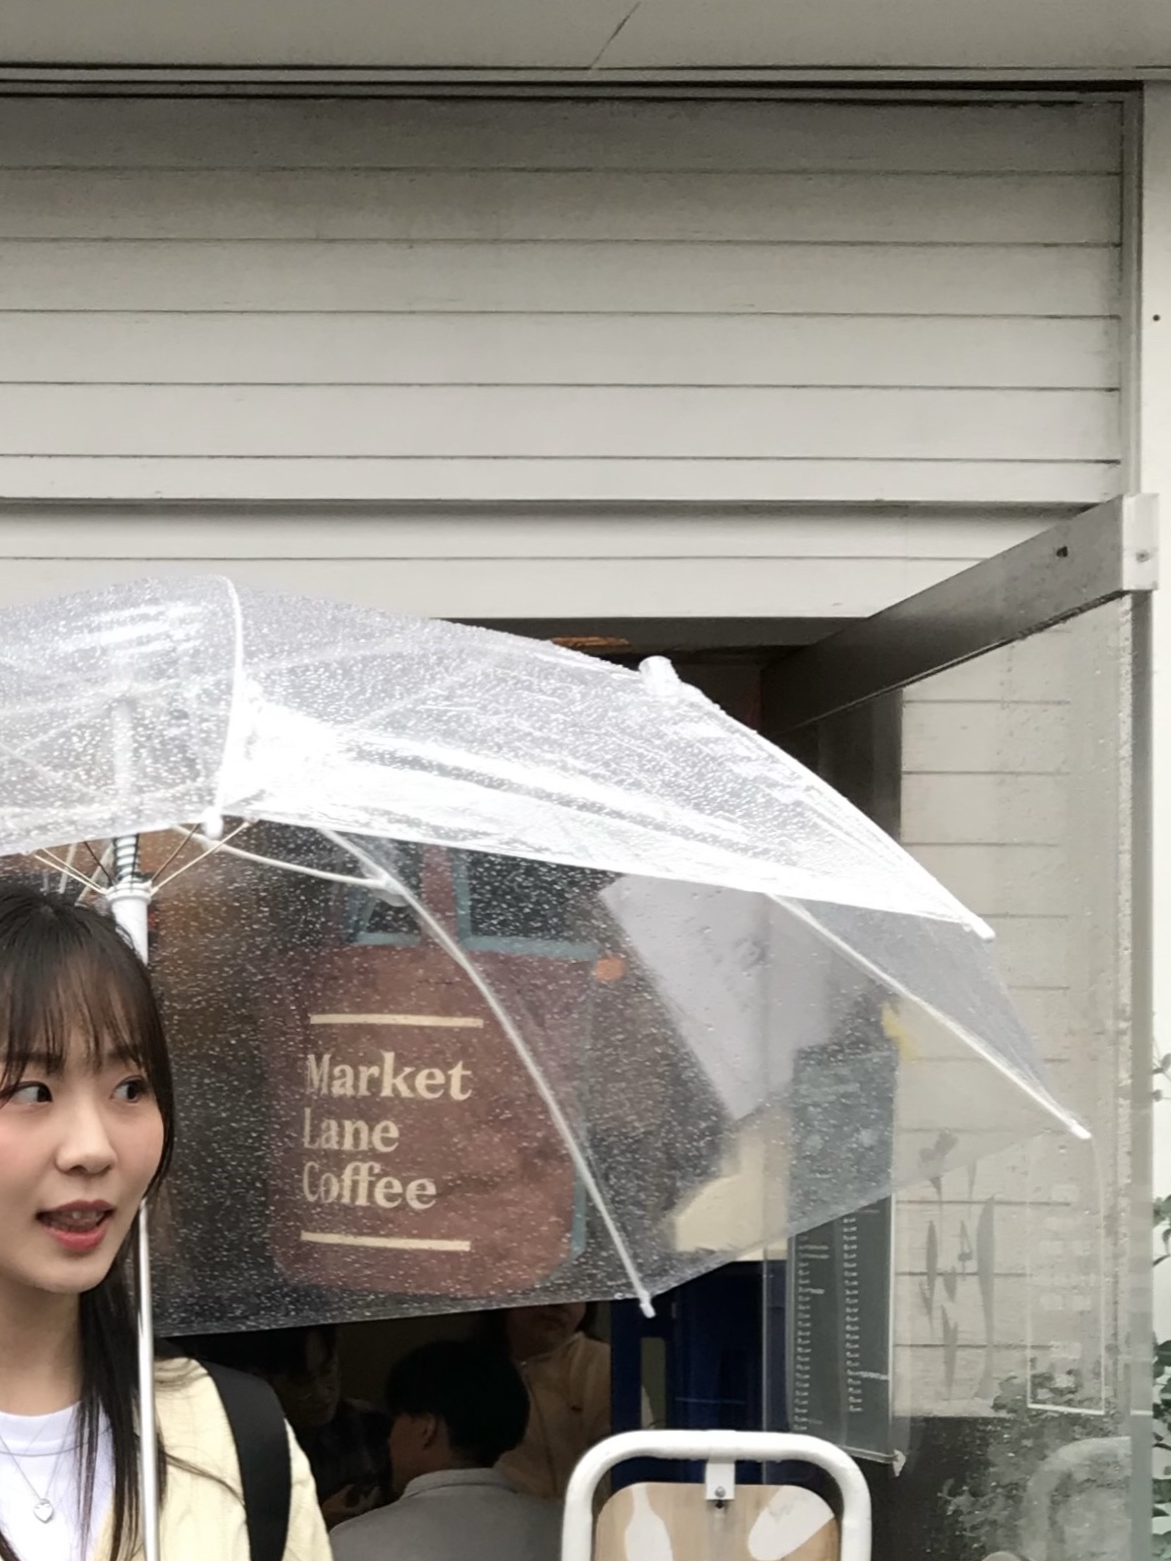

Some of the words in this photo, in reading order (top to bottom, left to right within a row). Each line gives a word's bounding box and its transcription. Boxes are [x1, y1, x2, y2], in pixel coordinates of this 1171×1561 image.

[306, 1051, 473, 1101] Market
[302, 1107, 400, 1153] Lane
[302, 1160, 438, 1210] Coffee
